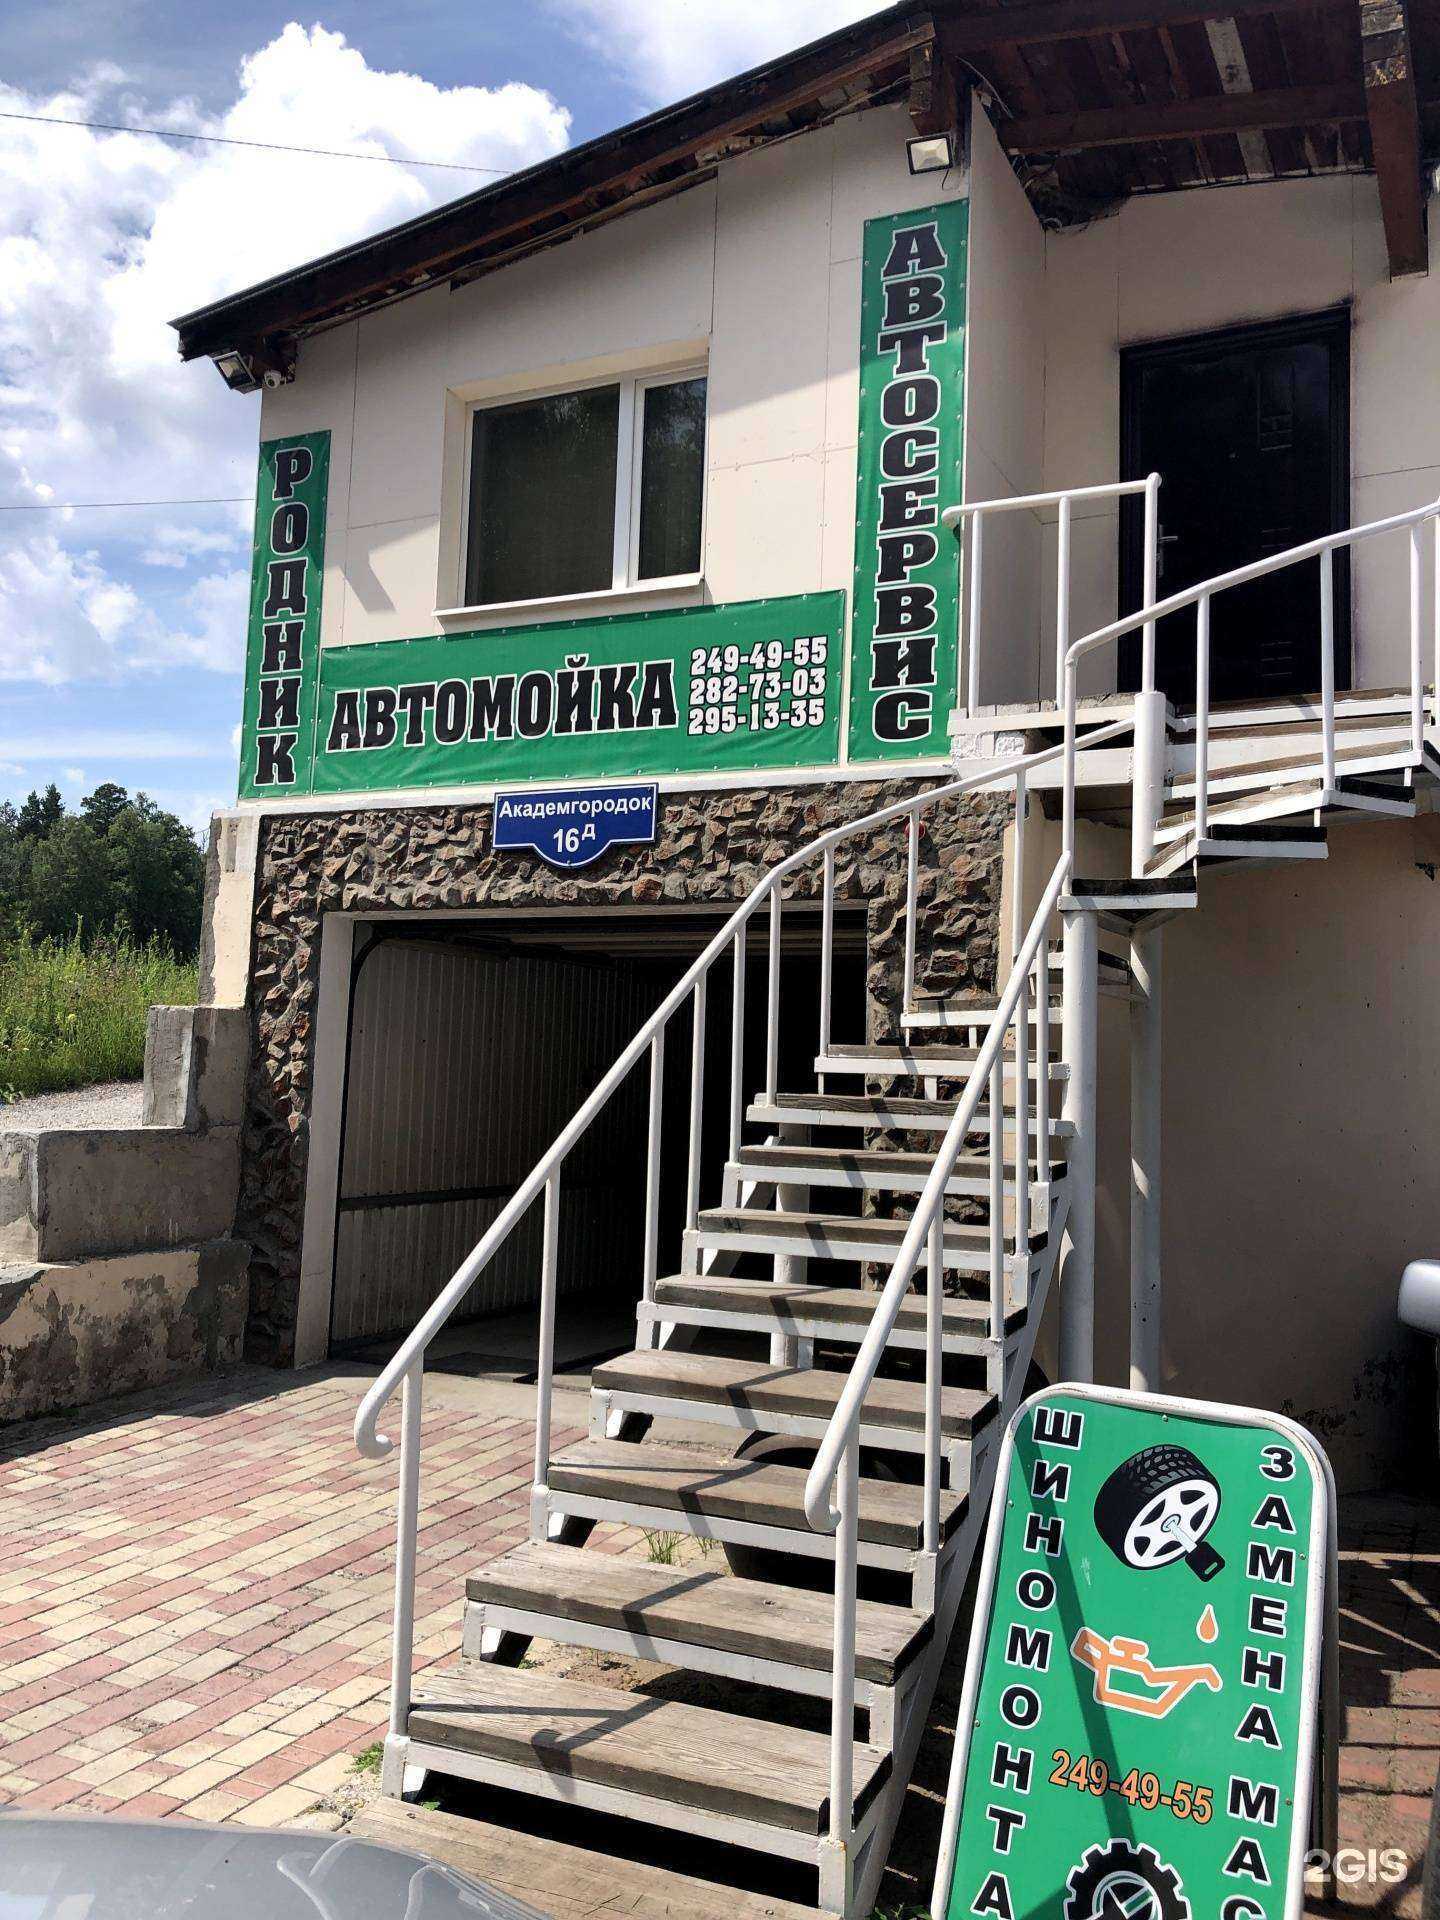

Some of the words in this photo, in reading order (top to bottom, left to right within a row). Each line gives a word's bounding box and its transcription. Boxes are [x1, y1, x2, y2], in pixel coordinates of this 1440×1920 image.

[869, 222, 947, 743] АВТОСЕРВИС
[253, 447, 312, 786] РОДНИК
[688, 666, 827, 705] 282-73-03
[690, 635, 828, 676] 249-49-55
[325, 654, 679, 753] АВТОМОЙКА
[687, 697, 825, 736] 295-13-35
[499, 796, 652, 818] Академгородок
[1235, 1445, 1297, 1749] ЗАМЕНА
[1050, 1748, 1214, 1825] 249-49-55
